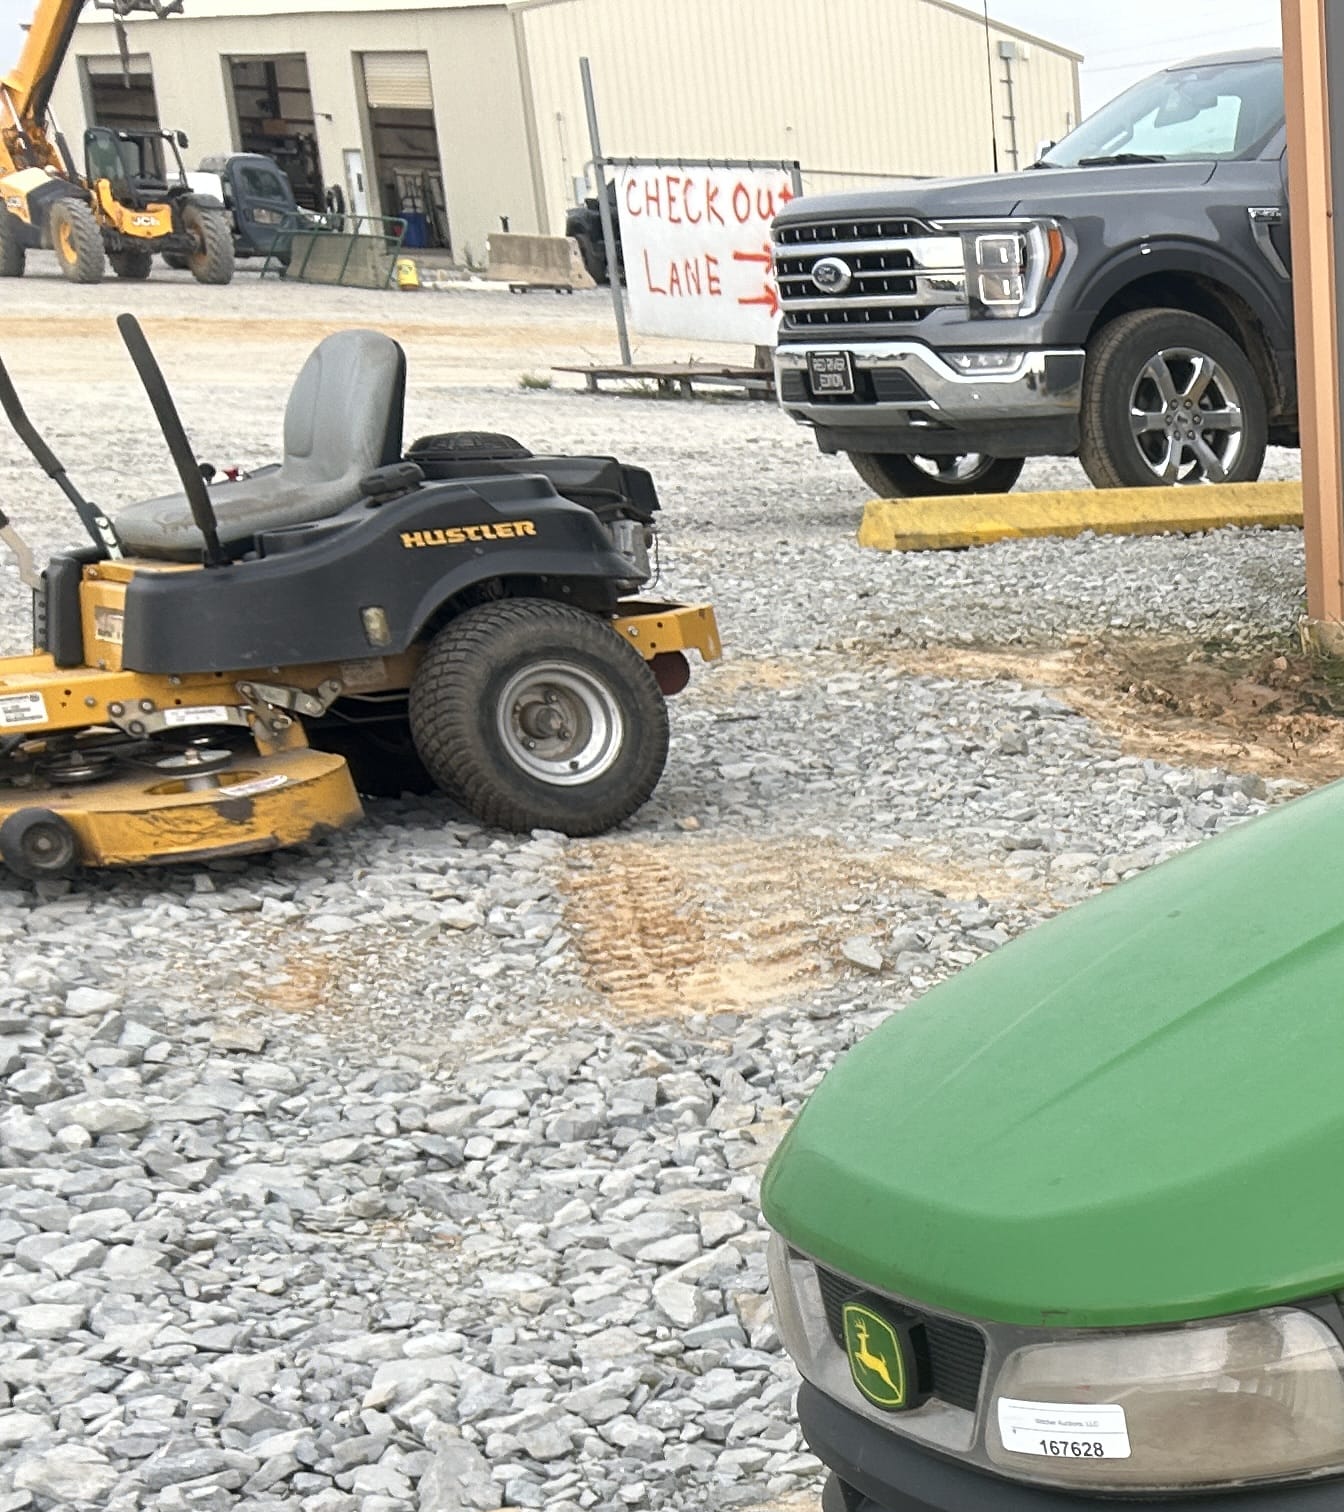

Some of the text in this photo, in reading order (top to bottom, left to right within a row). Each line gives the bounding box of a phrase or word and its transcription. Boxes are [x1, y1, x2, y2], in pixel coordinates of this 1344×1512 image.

[644, 249, 722, 296] LANE
[400, 520, 537, 548] HUSTLER
[1039, 1439, 1104, 1457] 167628
